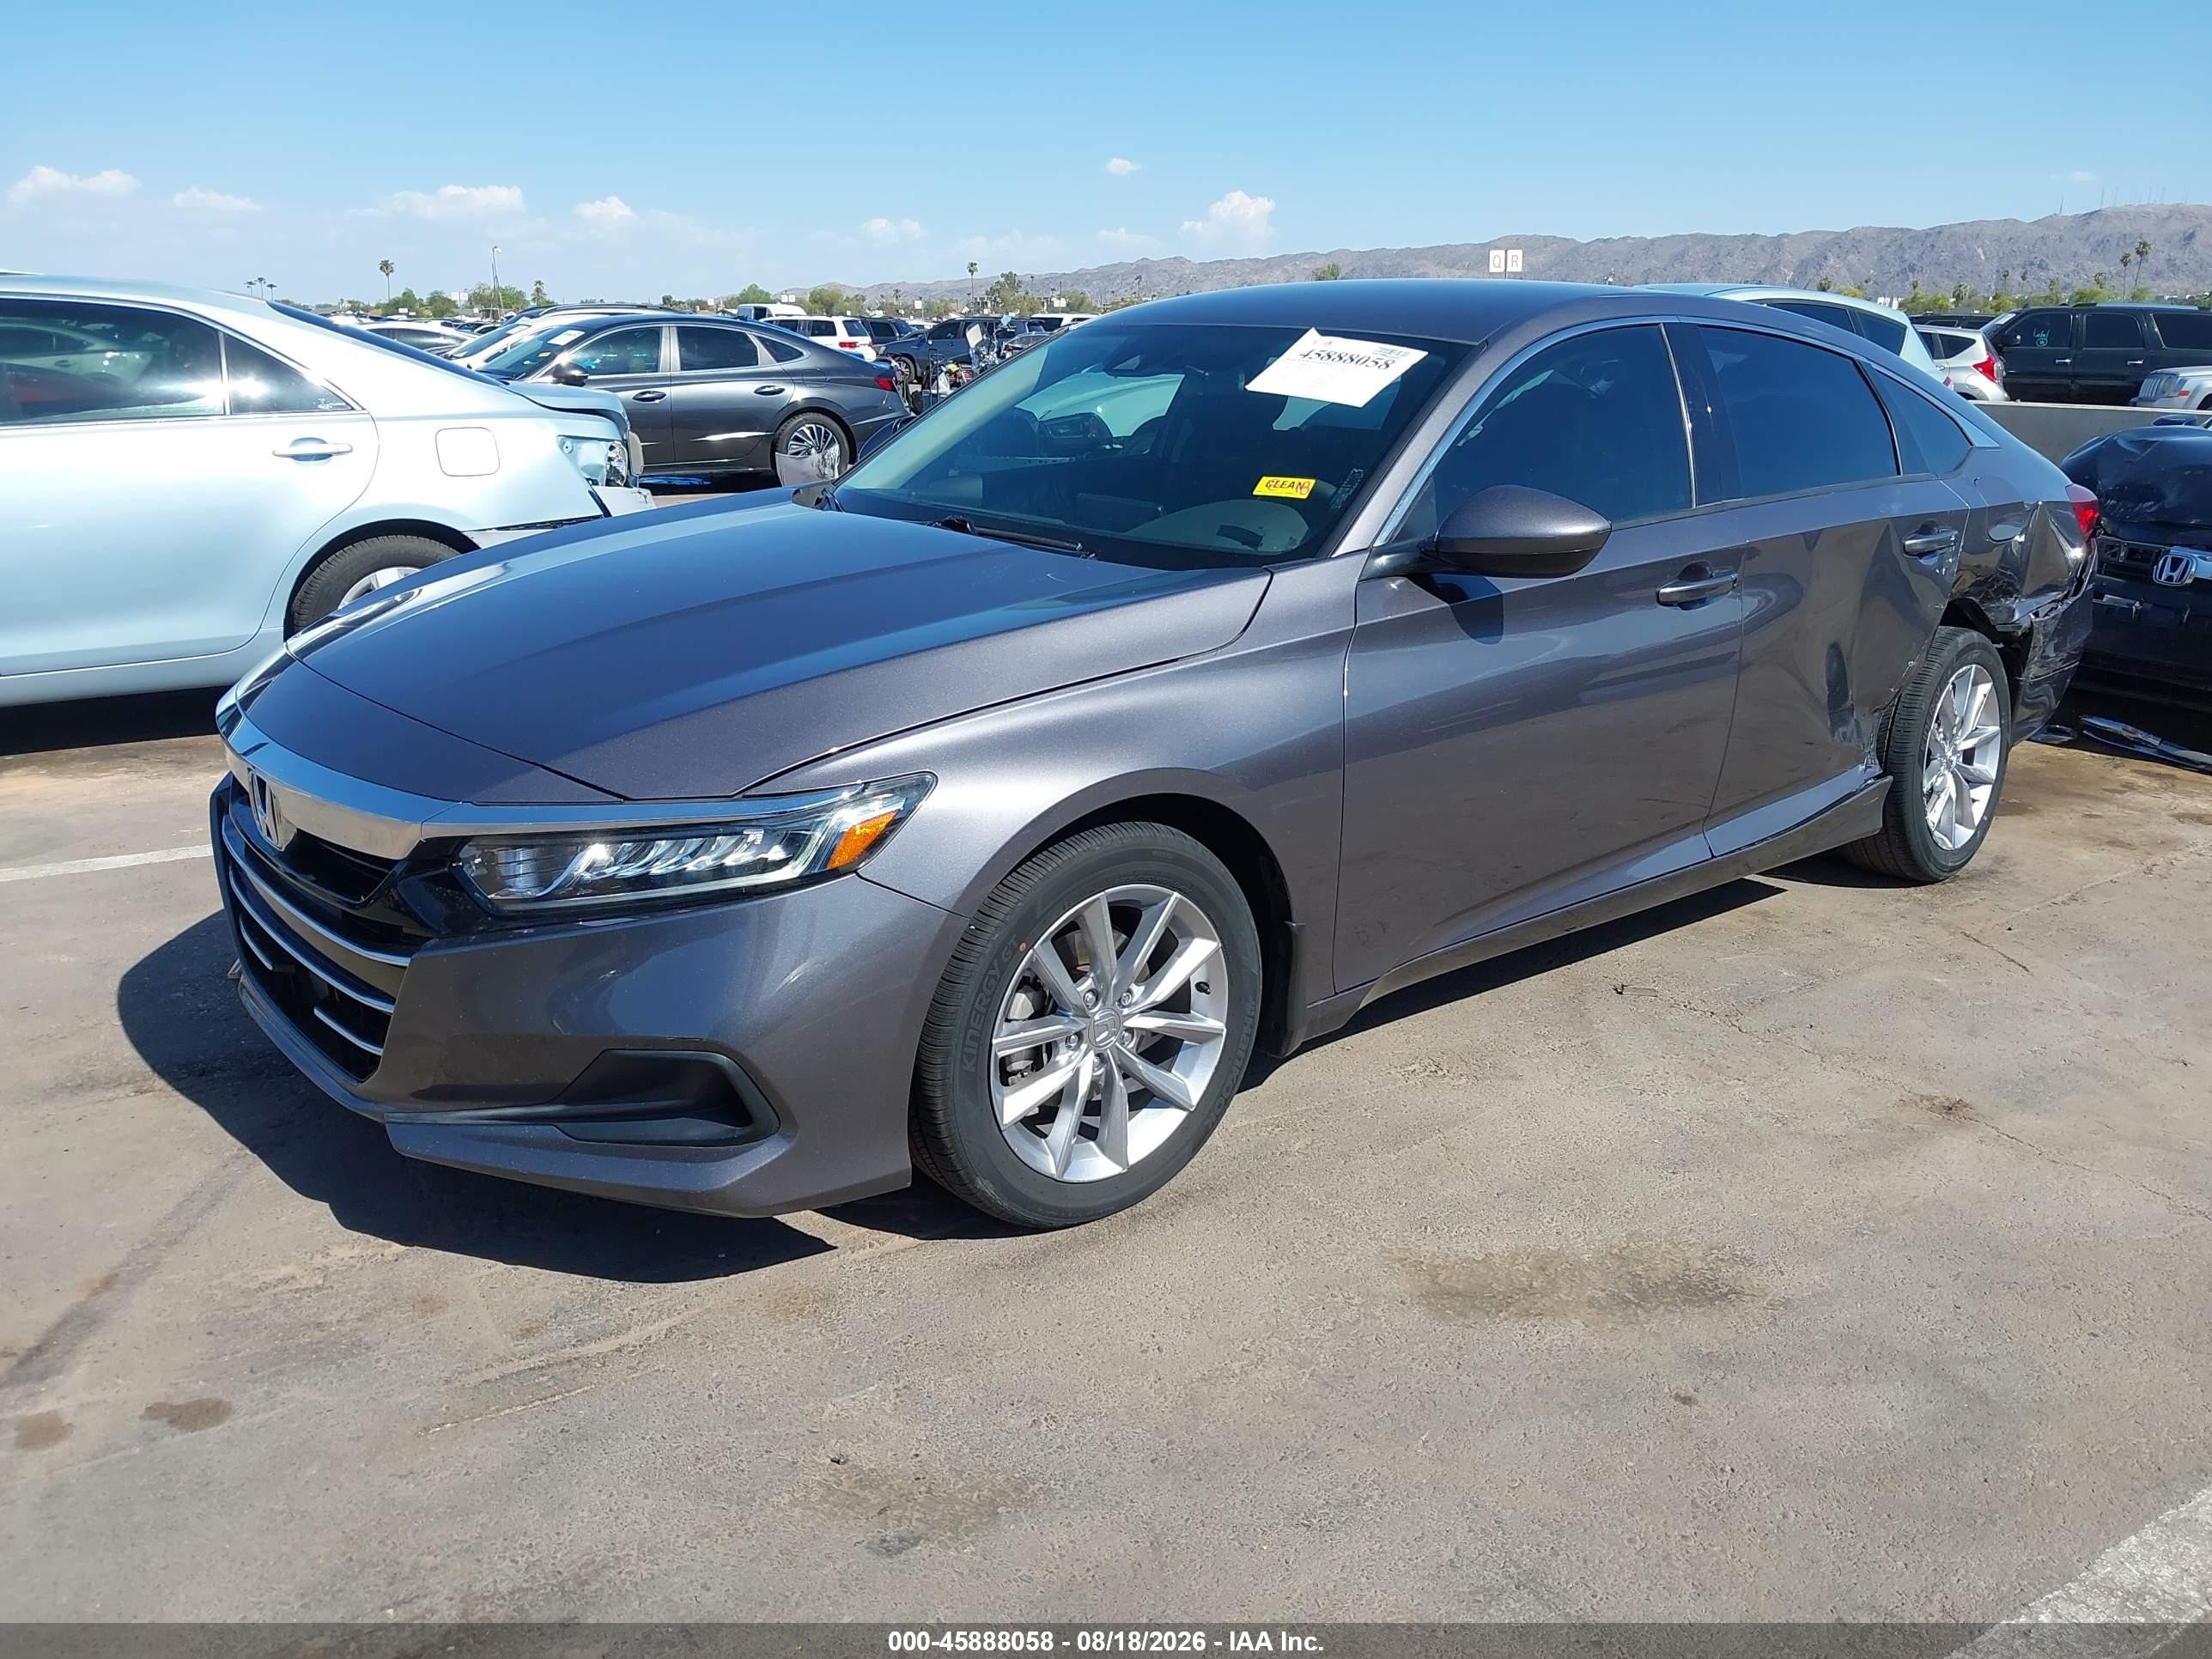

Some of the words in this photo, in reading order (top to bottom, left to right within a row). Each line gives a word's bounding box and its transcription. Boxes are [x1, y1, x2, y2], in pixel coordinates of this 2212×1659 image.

[1492, 254, 1502, 268] Q
[1299, 349, 1395, 369] 45888058
[963, 959, 1001, 1073] KINERGY
